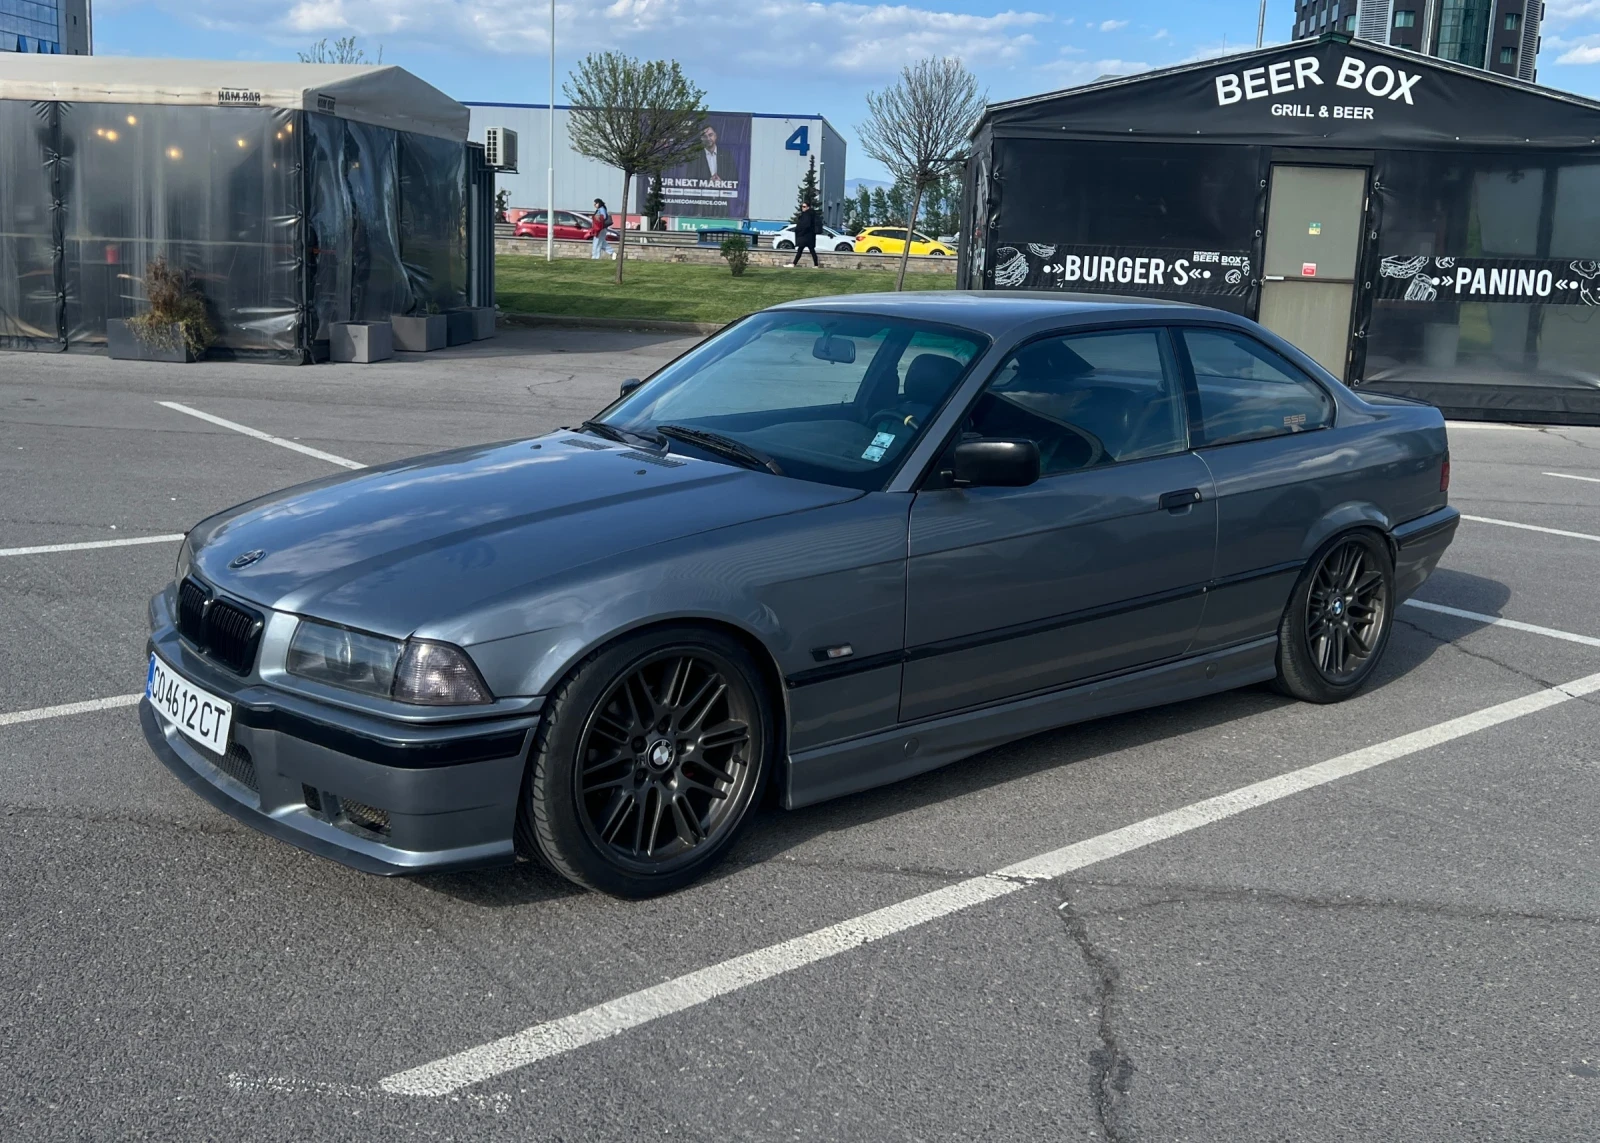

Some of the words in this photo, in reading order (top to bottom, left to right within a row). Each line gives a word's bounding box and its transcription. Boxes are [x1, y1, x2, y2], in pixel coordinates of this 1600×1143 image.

[1215, 56, 1324, 106] BEER
[1336, 56, 1422, 106] BOX
[1271, 103, 1314, 117] GRILL
[1318, 105, 1329, 118] &
[1333, 106, 1374, 119] BEER
[785, 125, 810, 156] 4
[648, 177, 673, 186] YUR
[675, 179, 698, 188] NEXT
[699, 180, 738, 189] MARKET
[1065, 255, 1190, 286] BURGER'S
[1221, 256, 1241, 264] BOX
[1455, 267, 1552, 296] PANINO
